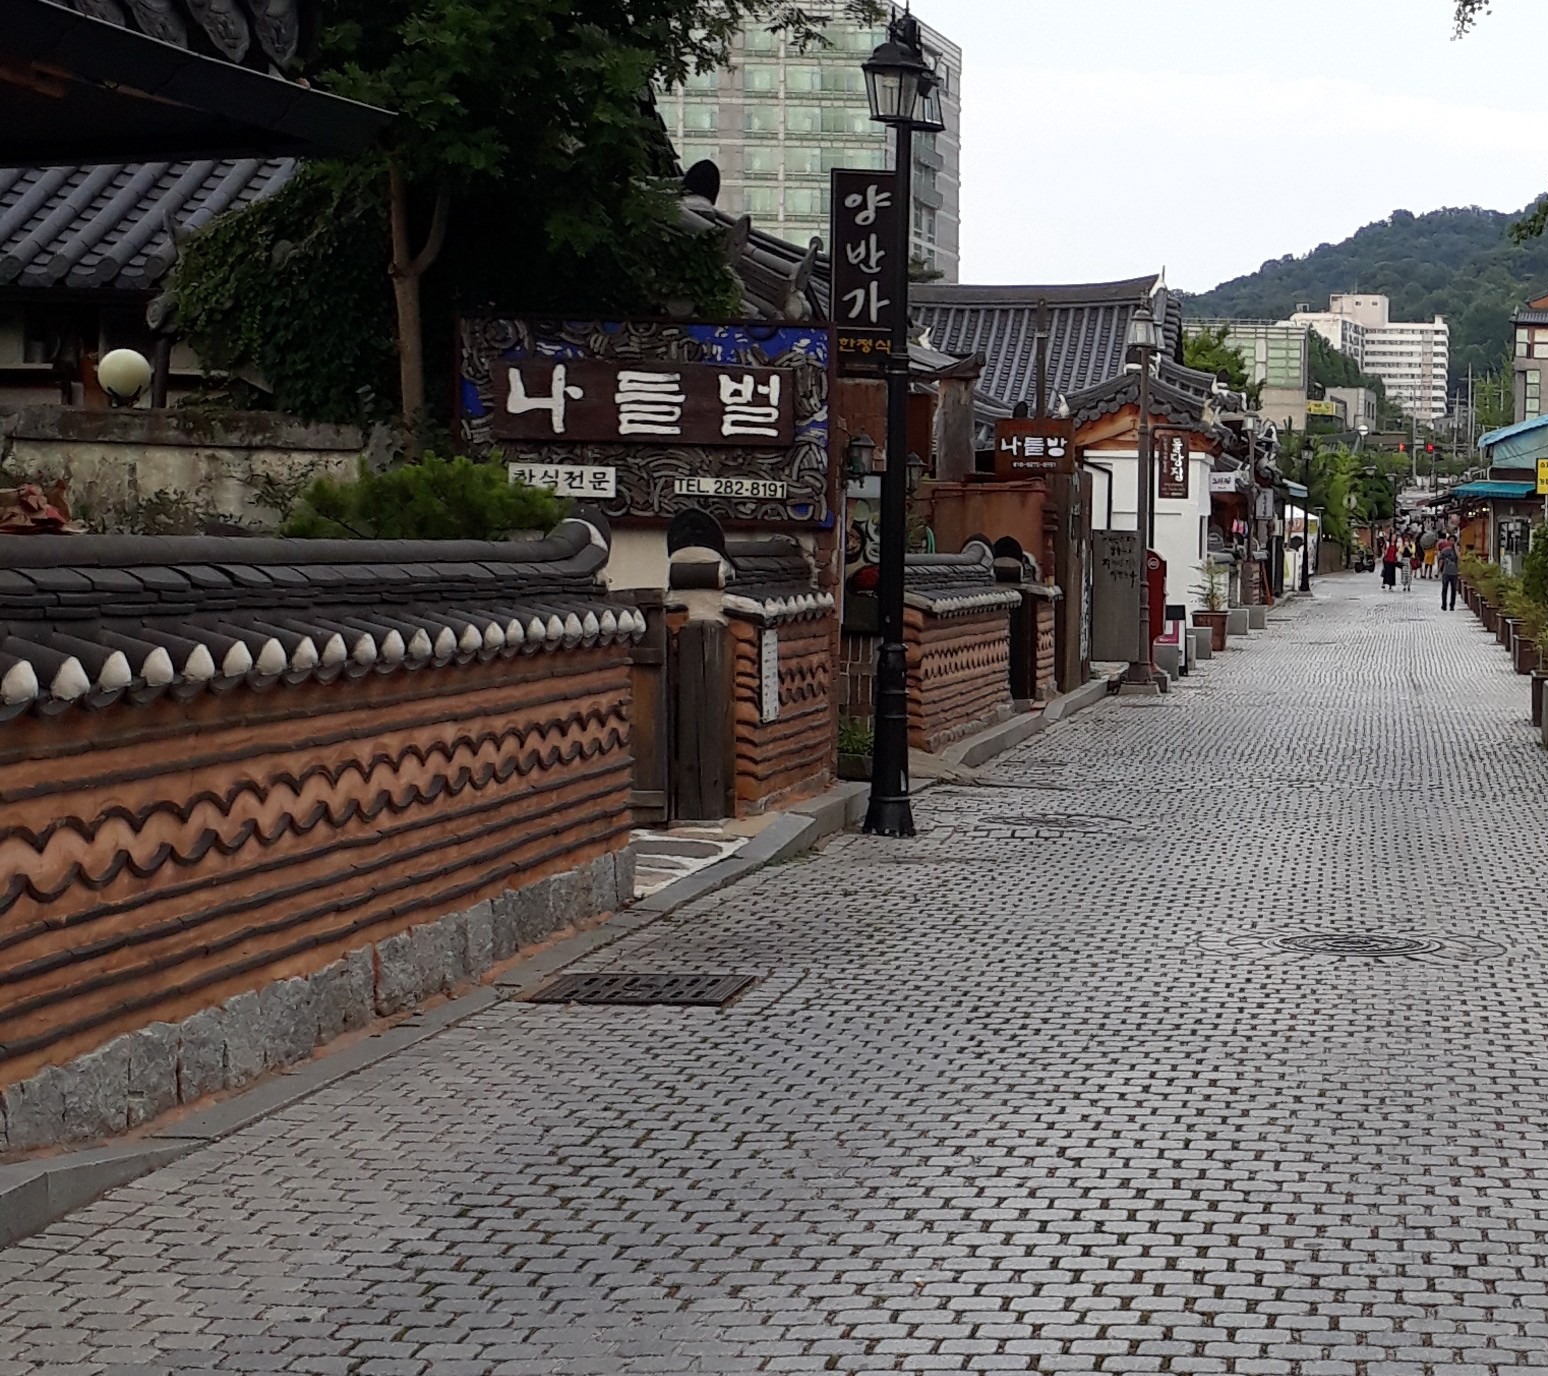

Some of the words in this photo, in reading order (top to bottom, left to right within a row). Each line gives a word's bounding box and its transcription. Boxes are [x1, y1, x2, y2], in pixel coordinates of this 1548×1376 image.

[842, 184, 892, 324] 양반가
[838, 337, 891, 355] 한정식
[507, 364, 780, 436] 나들벌
[1000, 435, 1069, 457] 나들방
[676, 478, 710, 494] TEL.
[713, 479, 787, 498] 282-8191
